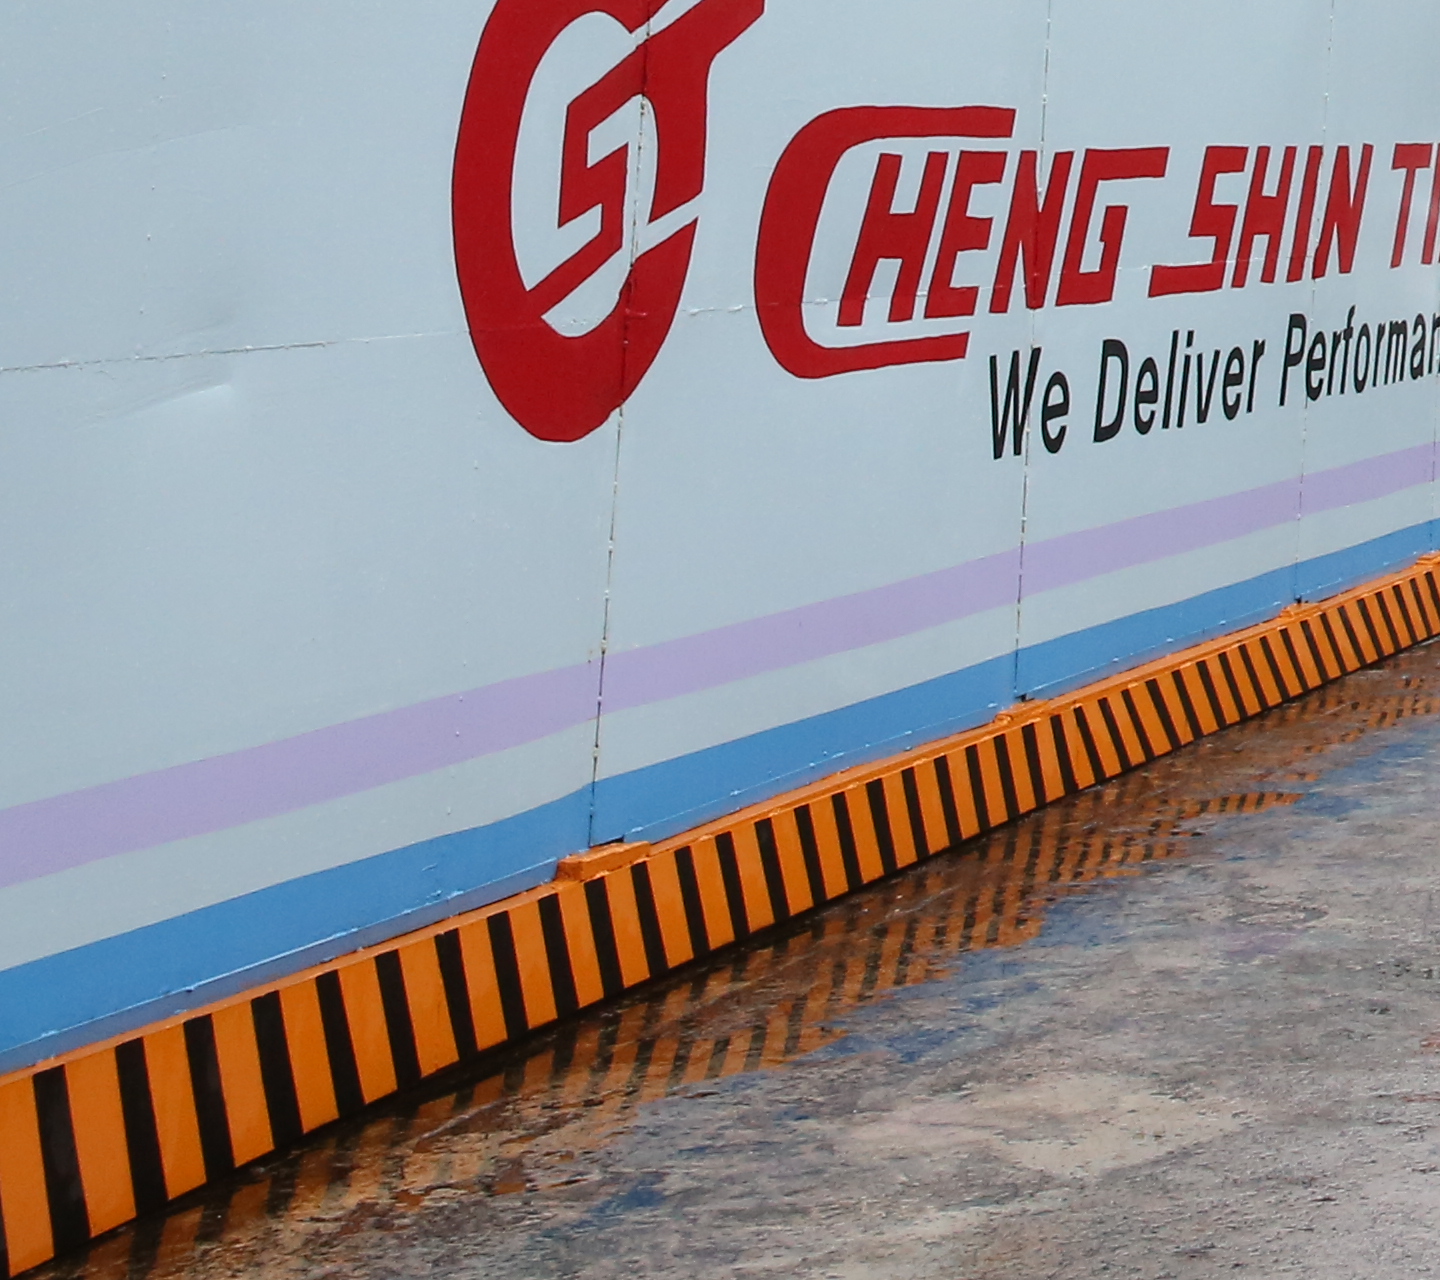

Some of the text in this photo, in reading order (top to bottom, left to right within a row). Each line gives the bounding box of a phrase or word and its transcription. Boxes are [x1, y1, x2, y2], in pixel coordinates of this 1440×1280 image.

[754, 105, 1170, 379] CHENG
[1148, 143, 1374, 298] SHIN
[989, 347, 1070, 460] We
[1093, 329, 1266, 443] Deliver
